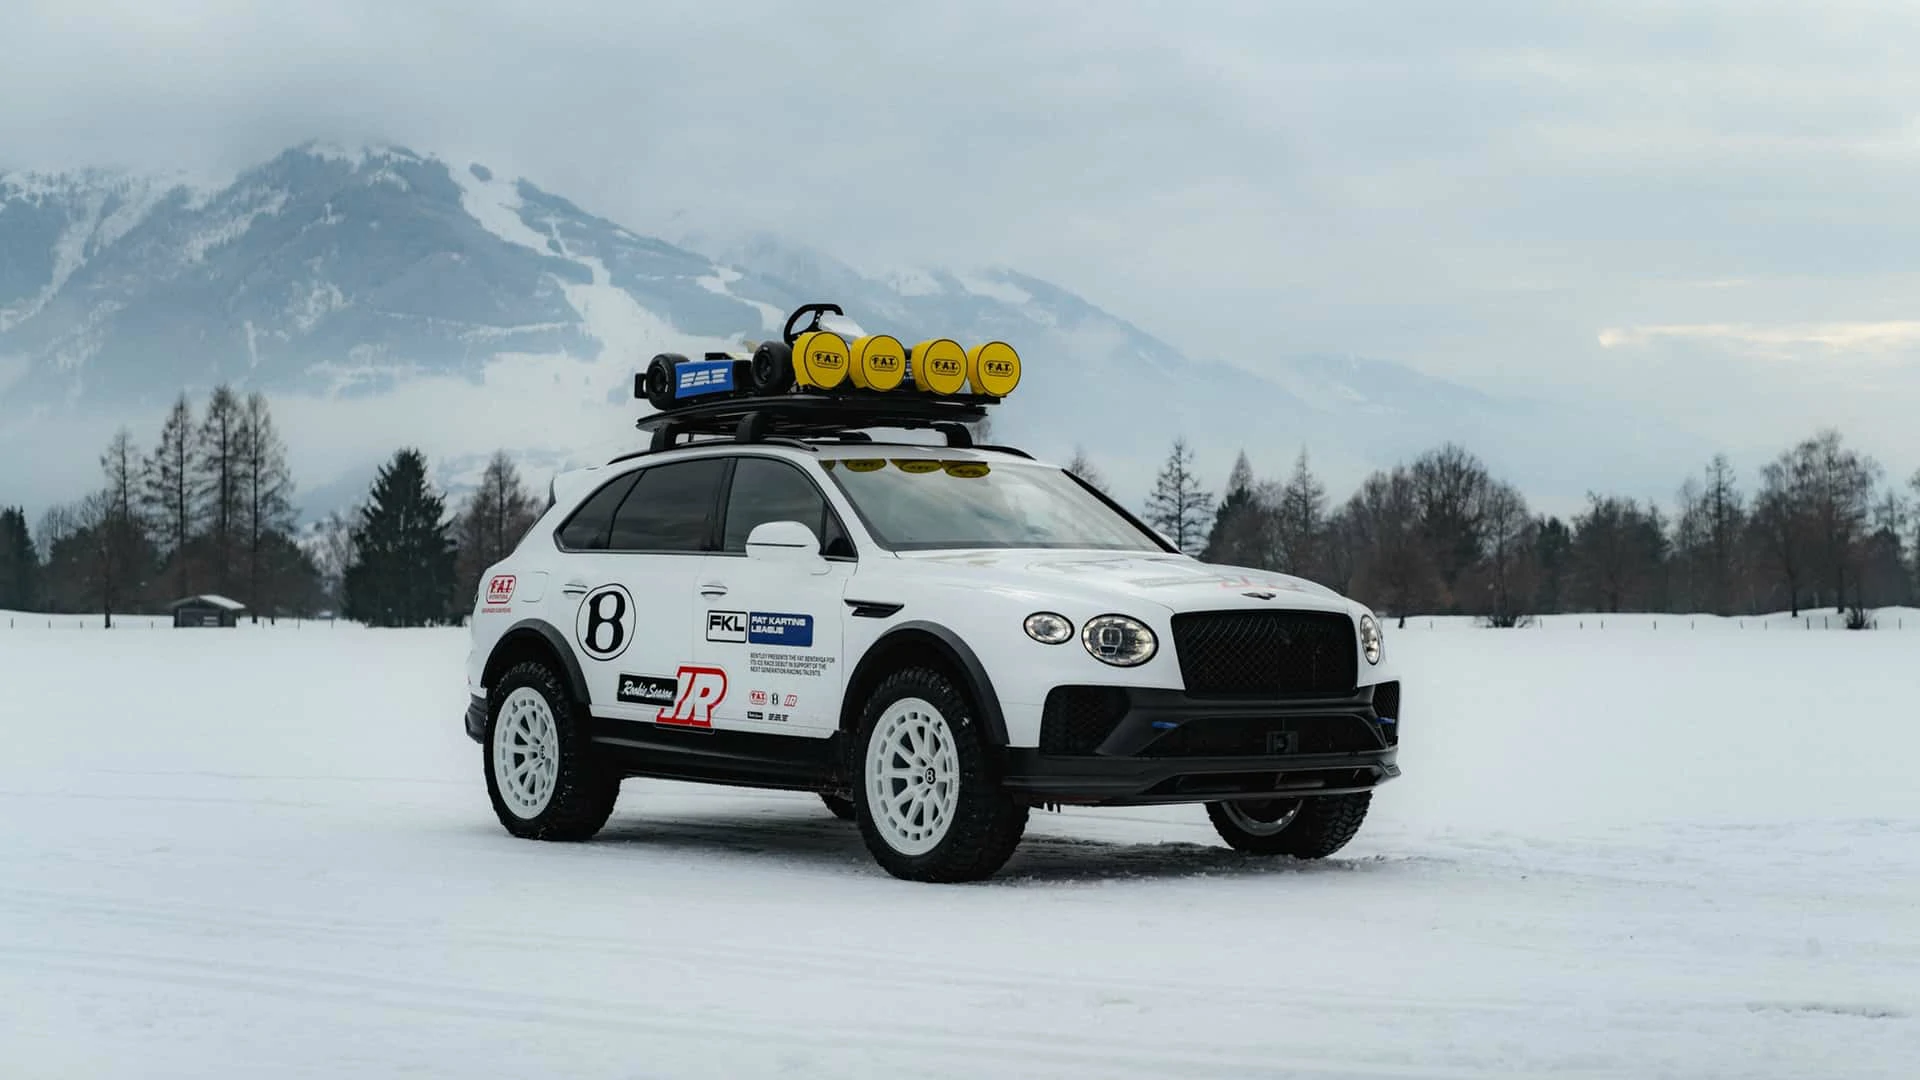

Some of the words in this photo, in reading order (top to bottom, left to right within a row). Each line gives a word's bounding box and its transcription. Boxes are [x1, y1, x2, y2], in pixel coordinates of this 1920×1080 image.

[709, 615, 745, 632] FKL
[751, 615, 767, 625] FAT
[768, 616, 806, 627] KARTING
[751, 625, 784, 635] LEAGUE
[793, 661, 812, 669] SUPPORT
[622, 680, 648, 697] Rookie
[646, 683, 674, 699] Season
